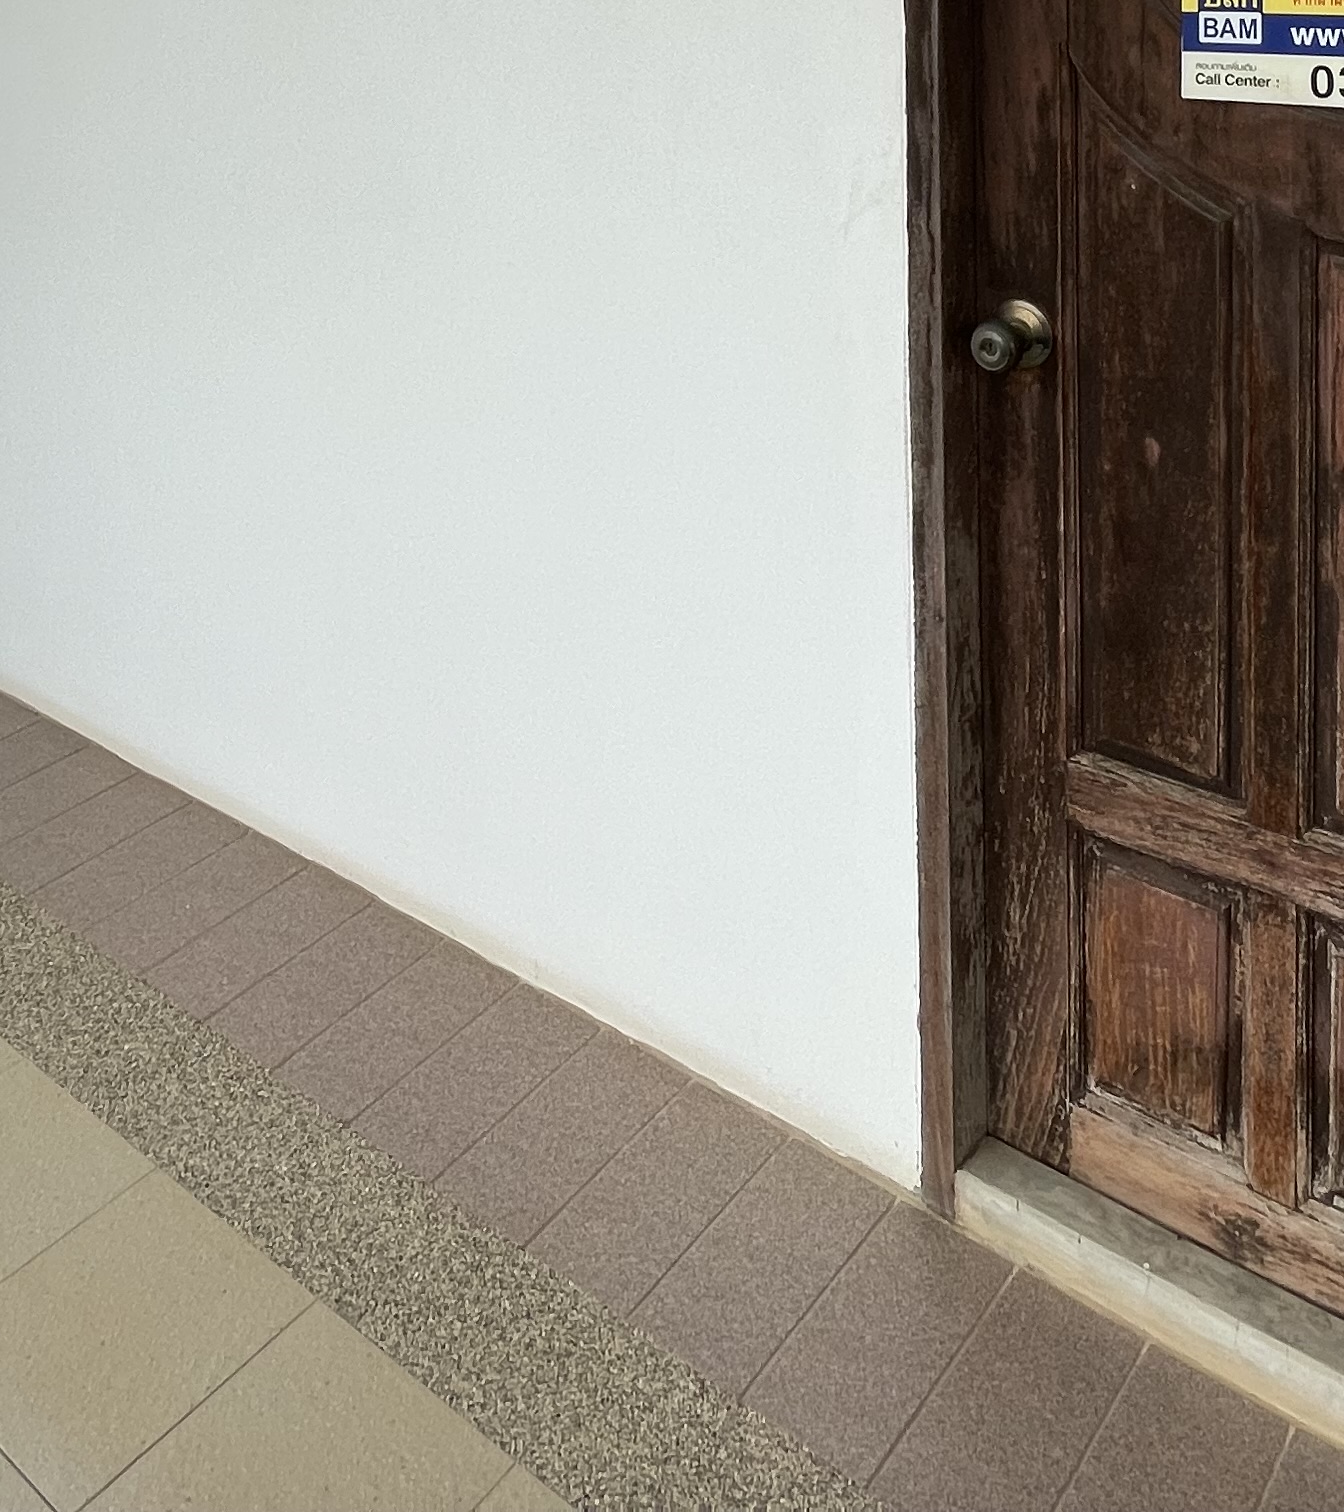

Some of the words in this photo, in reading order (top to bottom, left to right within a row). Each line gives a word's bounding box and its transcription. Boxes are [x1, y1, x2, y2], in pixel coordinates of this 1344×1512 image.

[1203, 17, 1258, 39] BAM
[1195, 72, 1221, 86] Call
[1224, 73, 1272, 88] Center
